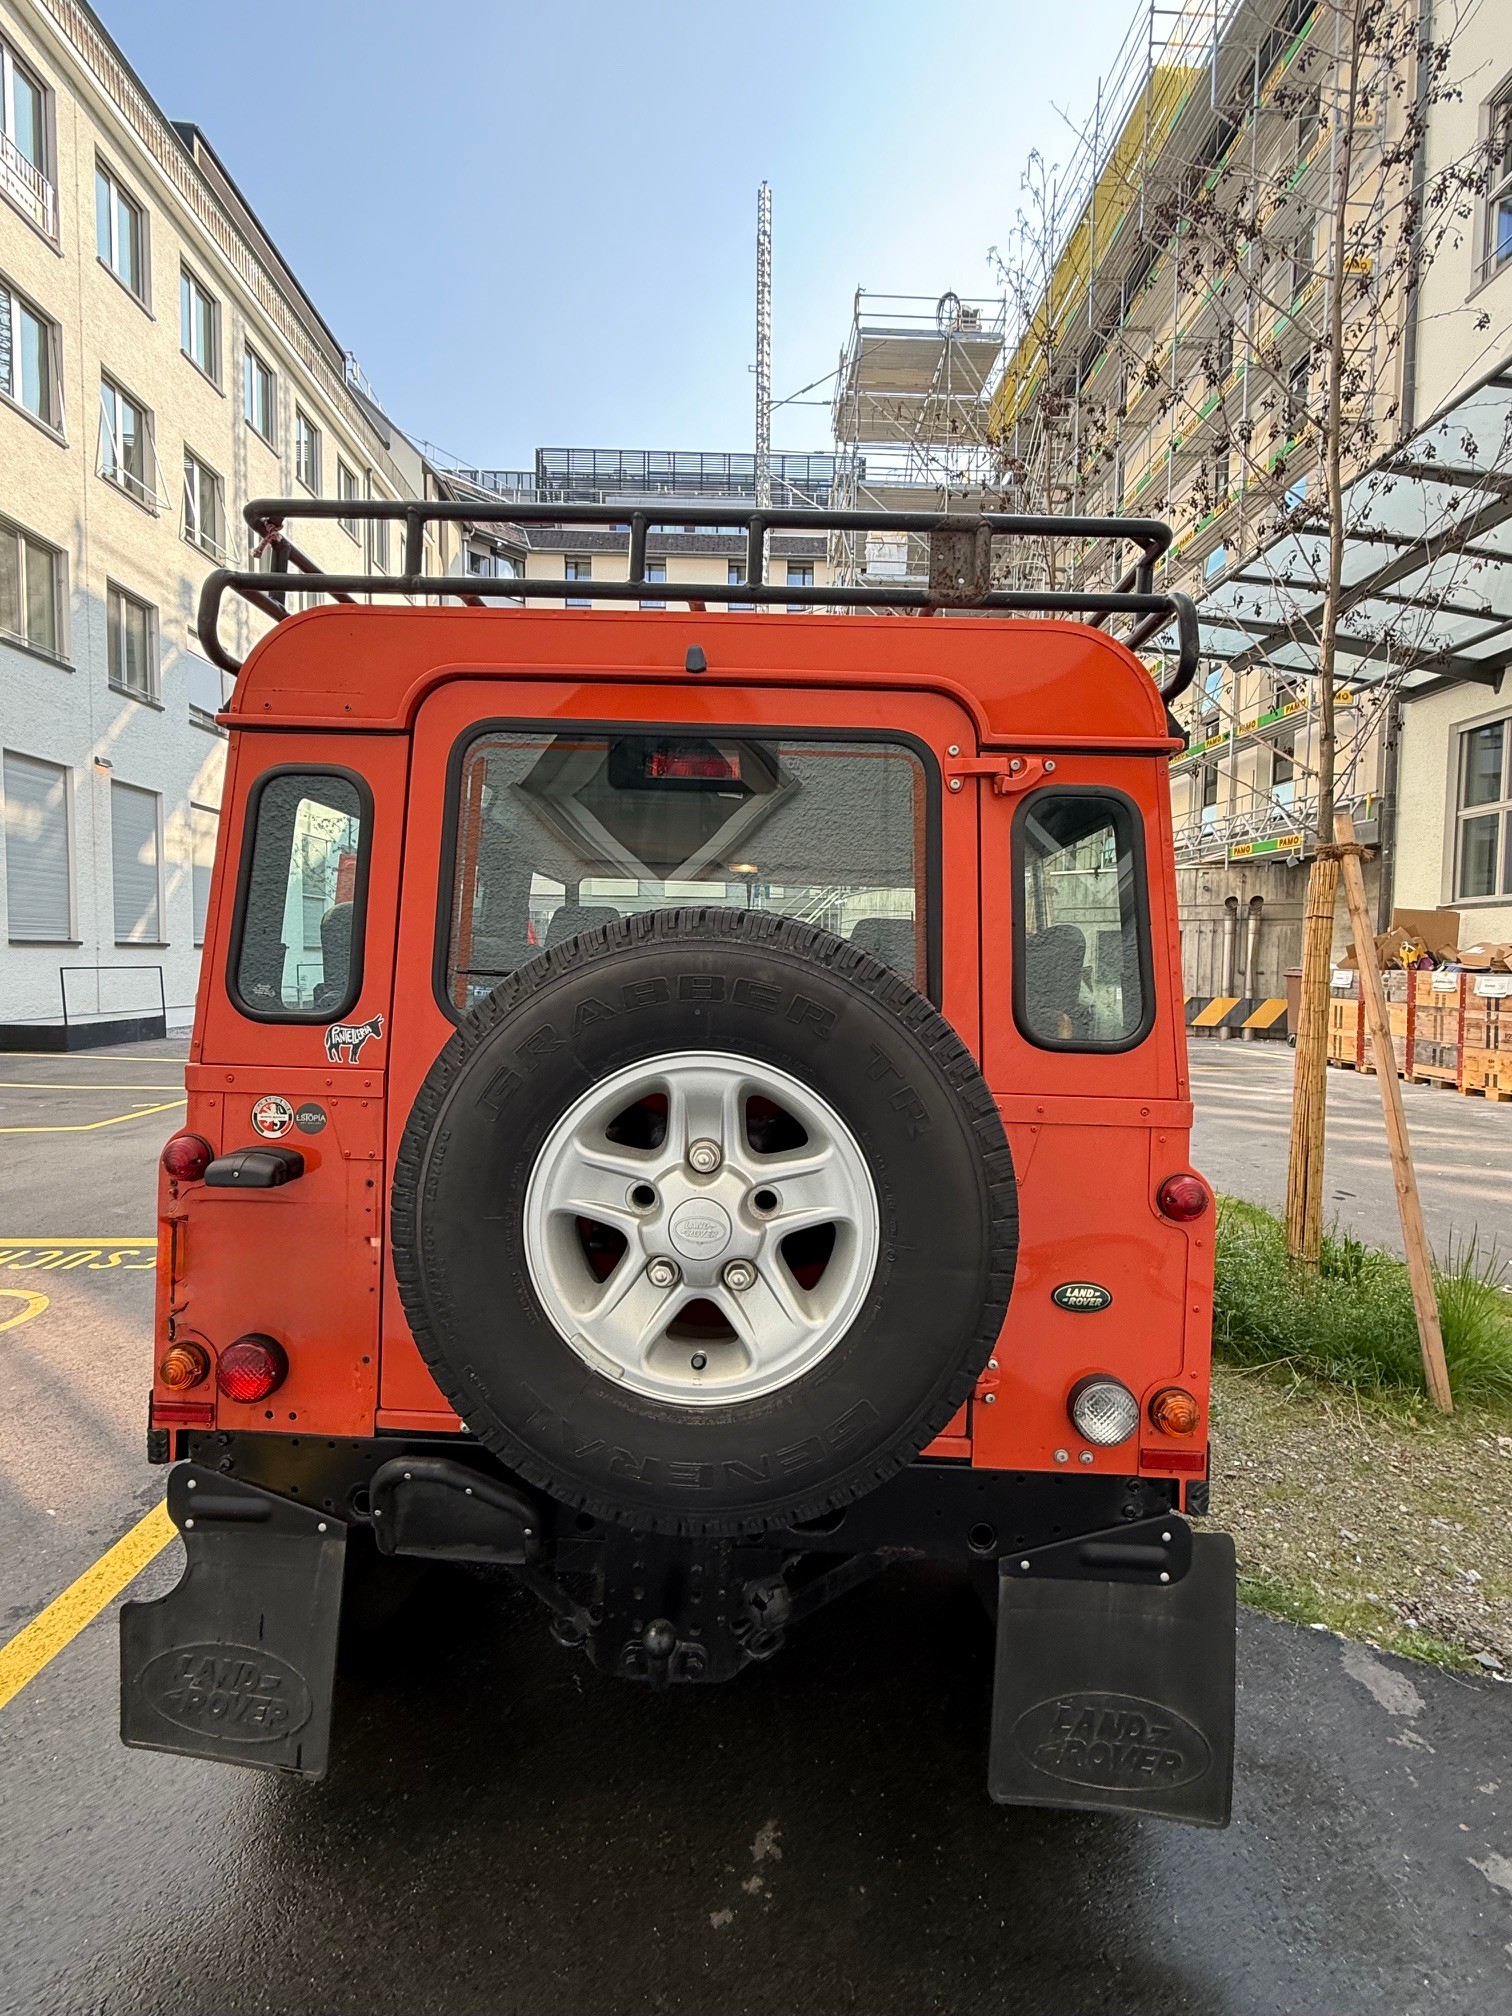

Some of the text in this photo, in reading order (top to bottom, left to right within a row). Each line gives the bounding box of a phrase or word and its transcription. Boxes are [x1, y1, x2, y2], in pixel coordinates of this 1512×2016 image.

[1341, 407, 1361, 415] AMO
[1285, 698, 1307, 713] PAMO
[1206, 735, 1222, 748] PAMO
[1233, 836, 1299, 855] PAMO PAMO
[473, 973, 840, 1123] GRABBER
[1065, 1287, 1095, 1298] LAND
[1067, 1297, 1103, 1307] ROVER
[174, 1653, 262, 1692] LAND
[175, 1688, 288, 1728] ROVER
[1050, 1702, 1148, 1742] LAND
[1054, 1737, 1185, 1780] ROVER
